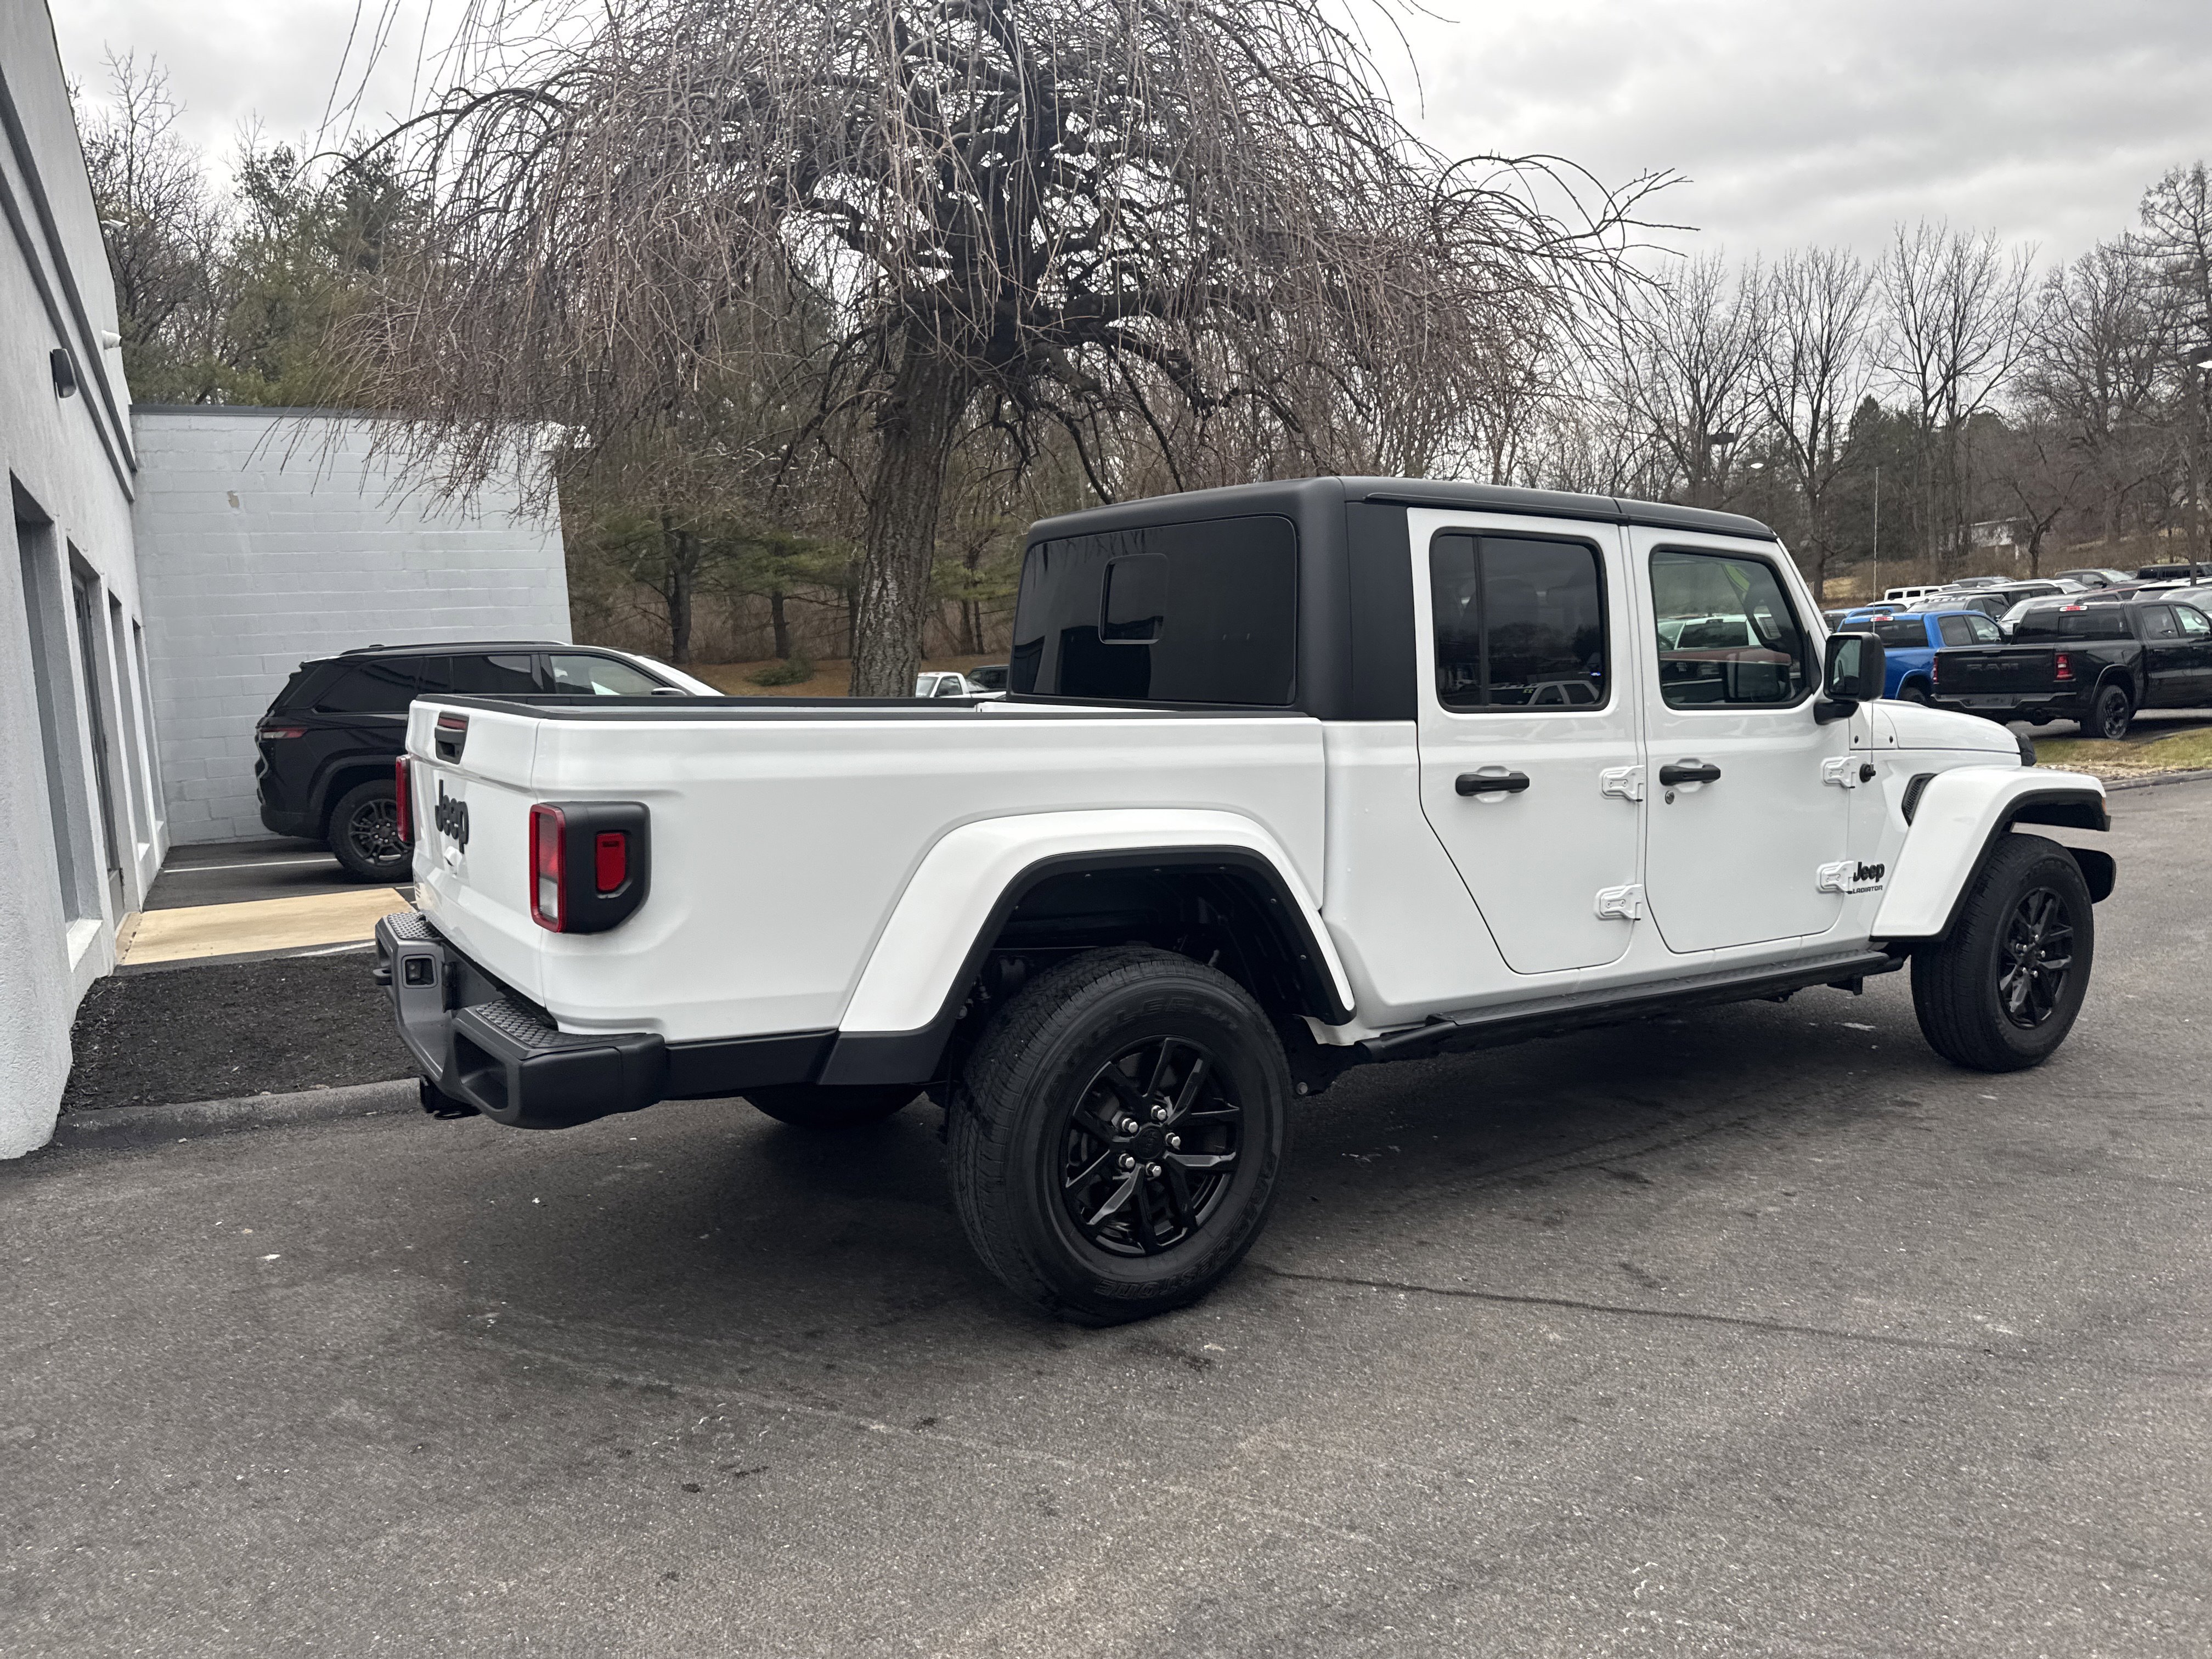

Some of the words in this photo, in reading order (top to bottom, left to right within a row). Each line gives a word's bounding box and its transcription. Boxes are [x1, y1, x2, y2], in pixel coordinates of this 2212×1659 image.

[435, 779, 469, 854] Jeep
[1853, 861, 1884, 883] Jeep
[1853, 885, 1883, 894] LADIATOR
